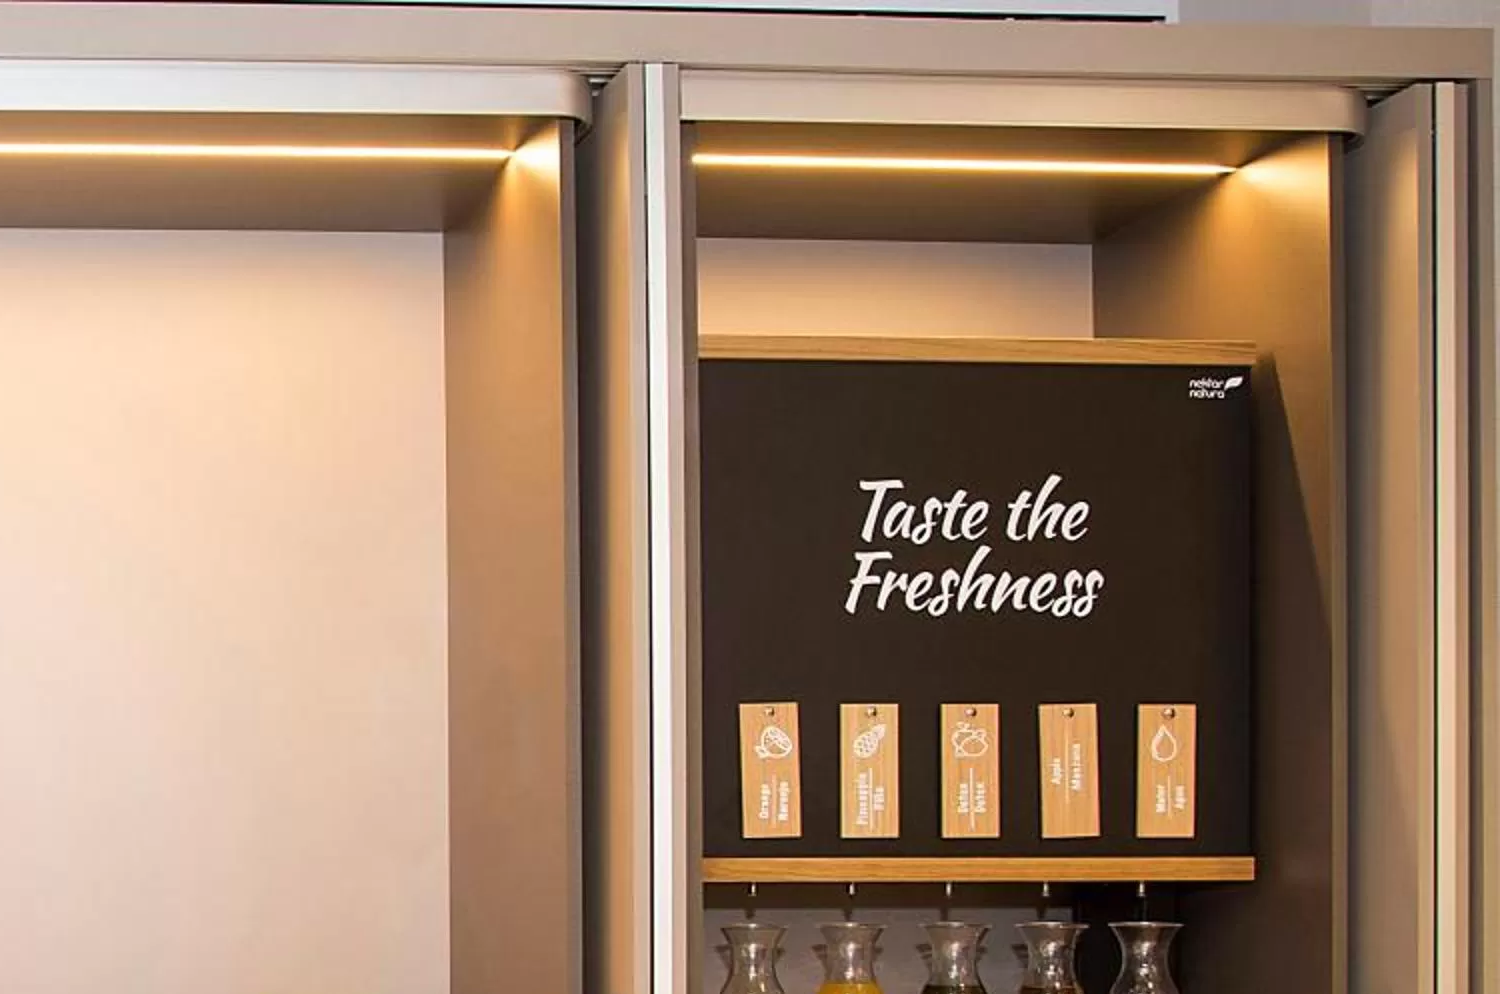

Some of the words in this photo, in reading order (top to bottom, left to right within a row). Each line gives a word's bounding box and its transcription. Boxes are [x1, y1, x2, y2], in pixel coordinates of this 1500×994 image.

[1189, 378, 1224, 389] nektar
[1189, 389, 1225, 399] natura
[858, 479, 990, 545] Taste
[1005, 474, 1090, 542] the
[844, 545, 1105, 618] Freshness
